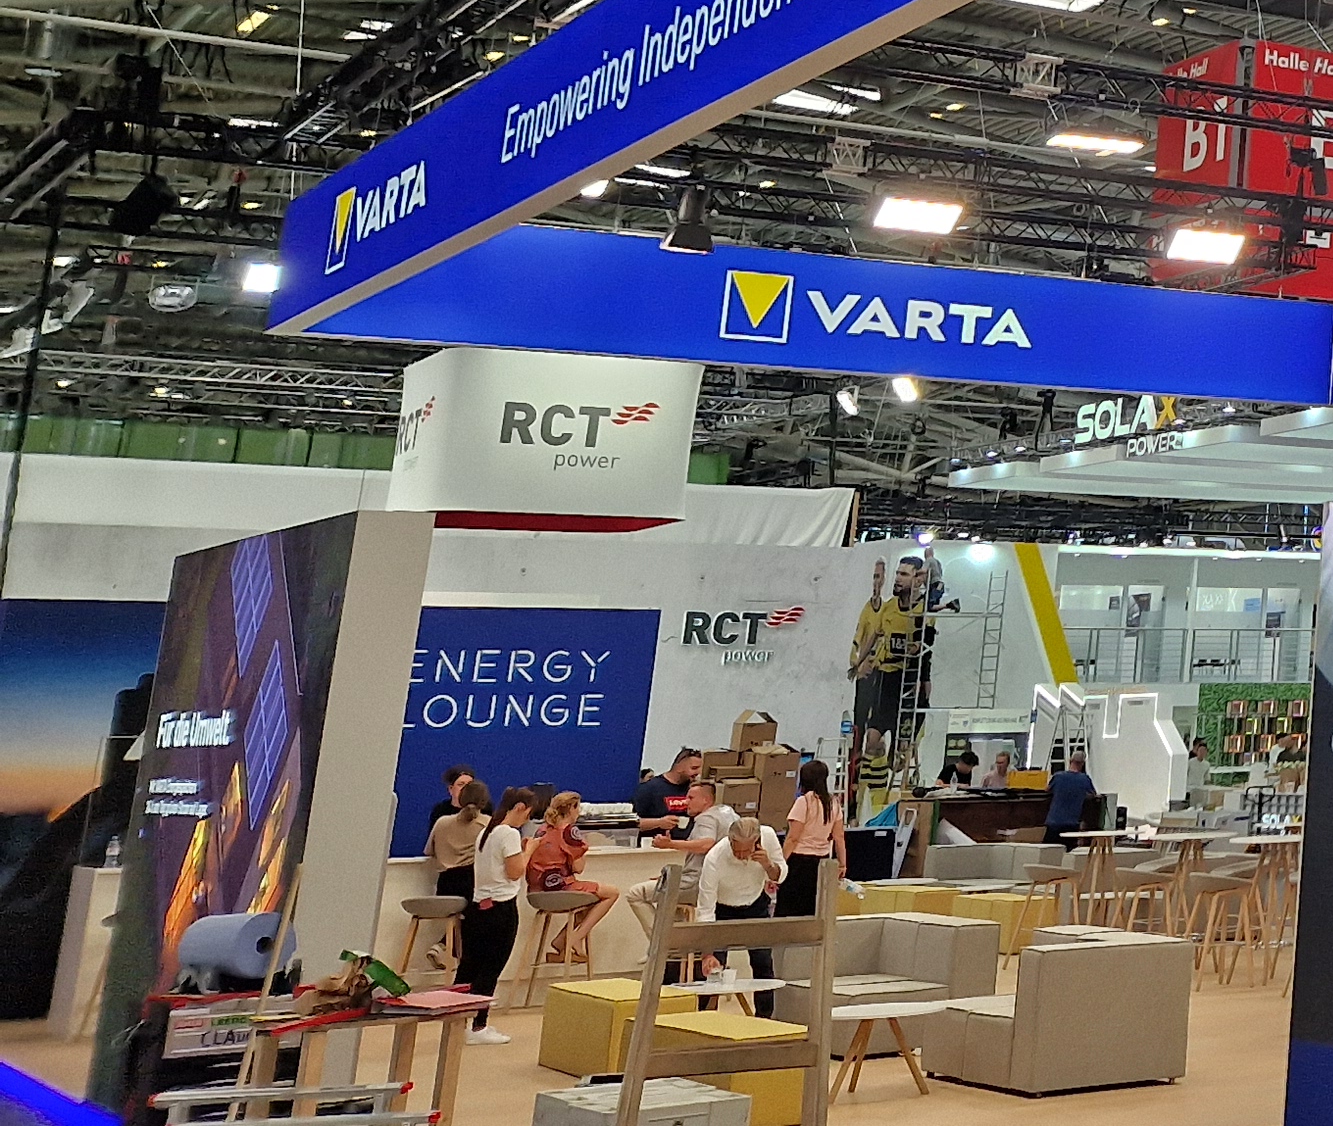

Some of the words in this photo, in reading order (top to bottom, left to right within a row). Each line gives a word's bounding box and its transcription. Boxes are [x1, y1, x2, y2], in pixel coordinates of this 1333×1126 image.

[1189, 59, 1208, 78] Hall
[1264, 49, 1309, 72] Halle
[500, 47, 635, 164] Empowering
[357, 160, 426, 241] VARTA
[807, 290, 1032, 349] VARTA
[500, 401, 612, 448] RCT
[1075, 394, 1178, 444] SOLAX
[553, 453, 621, 471] power
[1126, 432, 1183, 458] POWER
[682, 610, 770, 646] RCT
[722, 648, 774, 666] power
